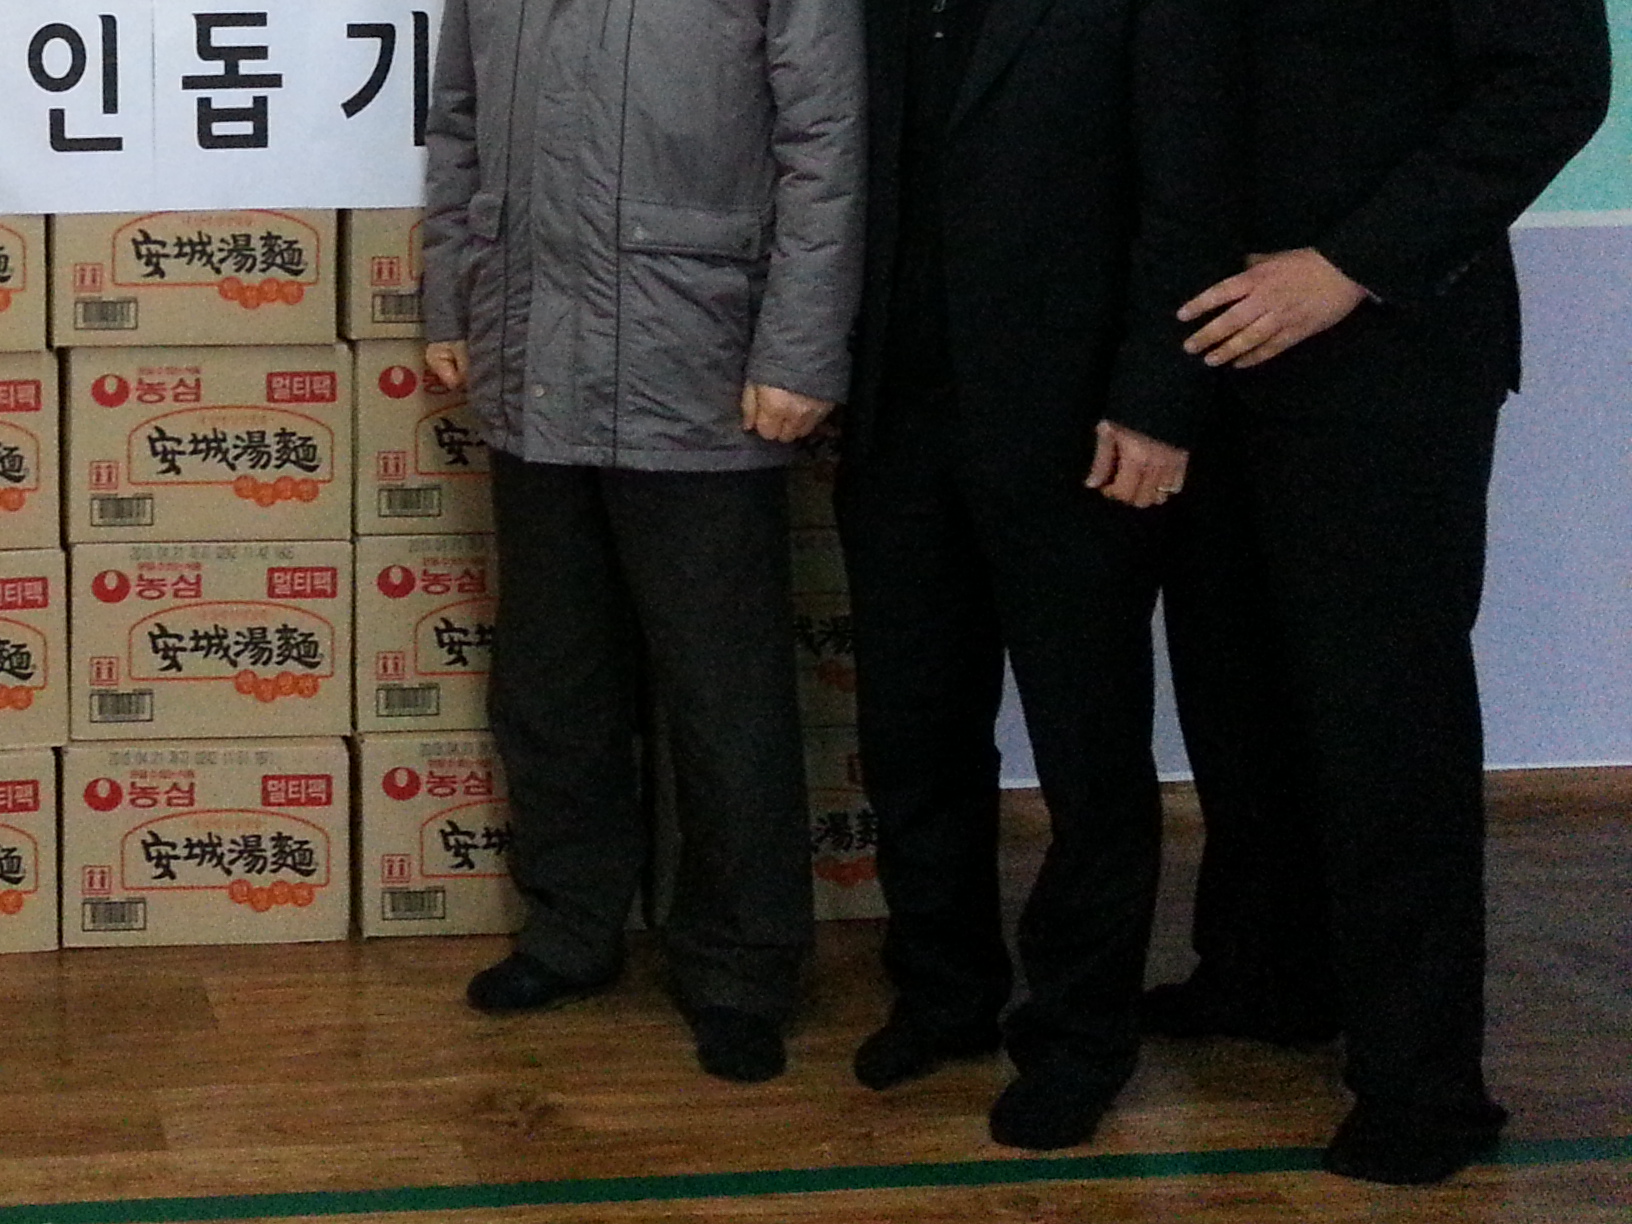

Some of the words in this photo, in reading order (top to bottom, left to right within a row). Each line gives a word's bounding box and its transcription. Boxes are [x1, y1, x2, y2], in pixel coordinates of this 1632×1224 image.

[132, 229, 308, 278] 安城湯麵
[135, 376, 203, 403] 농심
[271, 376, 334, 401] 멀티팩
[147, 426, 321, 475] 安城湯麵
[135, 572, 203, 600] 농심
[271, 570, 334, 597] 멀티팩
[421, 568, 486, 595] 농심
[147, 623, 322, 672] 安城湯麵
[128, 780, 196, 809] 농심
[267, 779, 329, 804] 멀티팩
[425, 770, 493, 798] 농심
[141, 831, 319, 881] 安城湯麵
